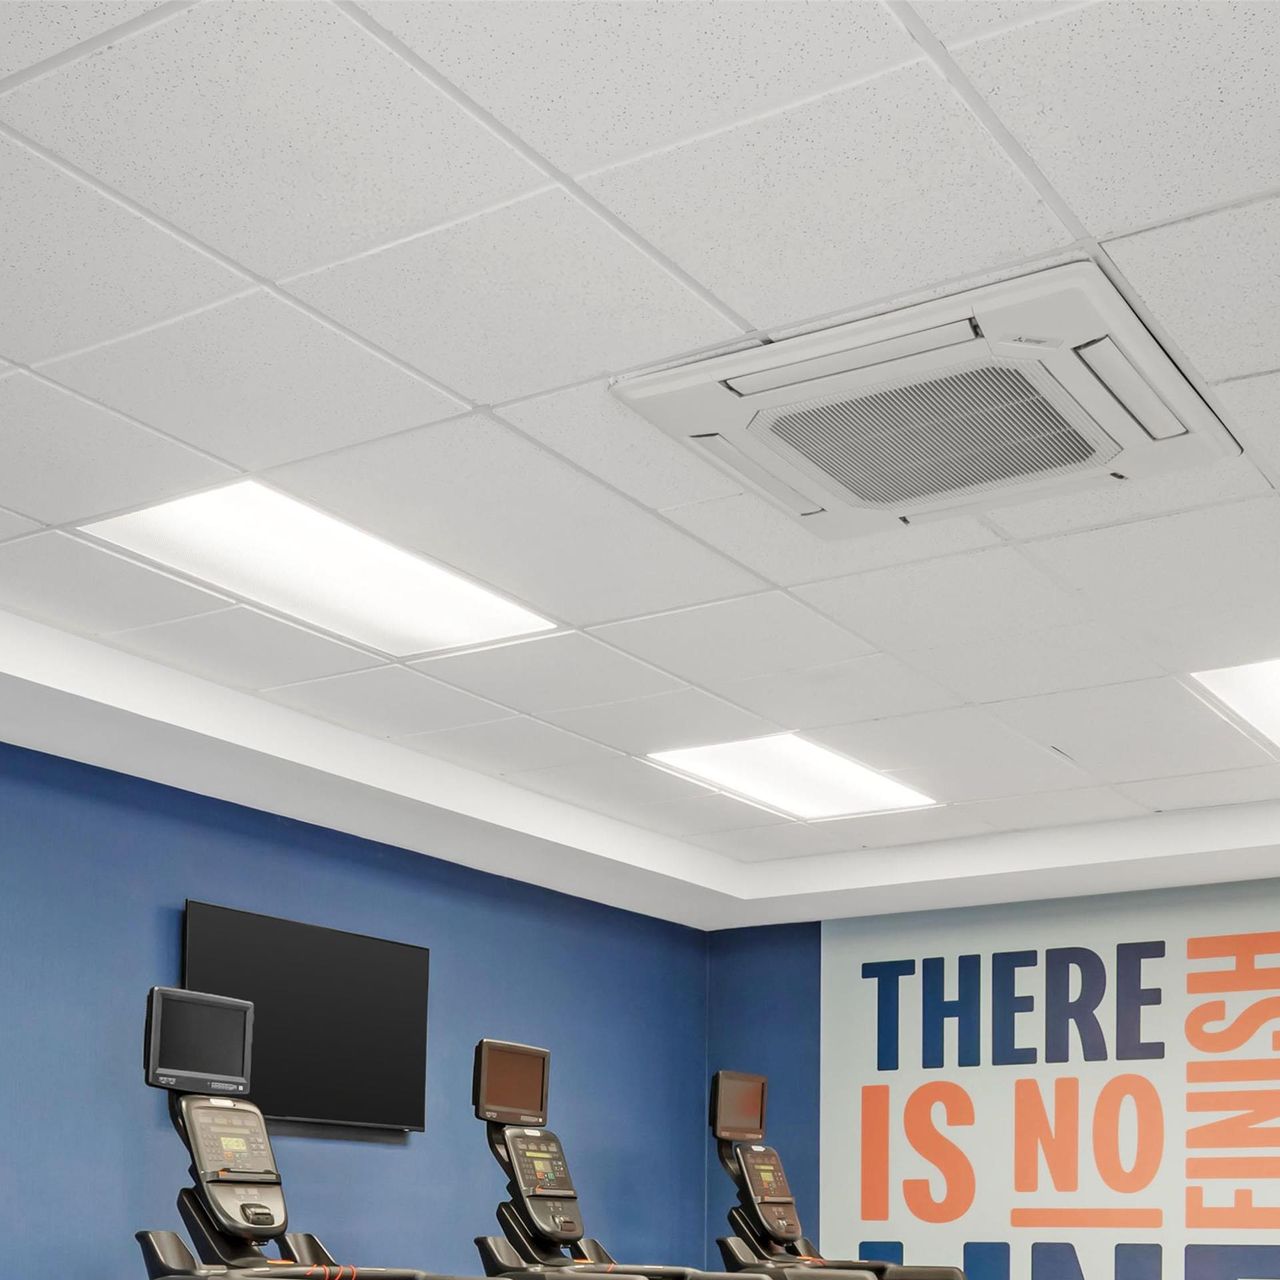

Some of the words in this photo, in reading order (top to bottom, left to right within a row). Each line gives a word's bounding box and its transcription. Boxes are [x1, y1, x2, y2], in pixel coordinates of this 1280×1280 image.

[861, 940, 1166, 1071] THERE
[860, 1081, 976, 1224] IS
[1014, 1073, 1165, 1194] NO
